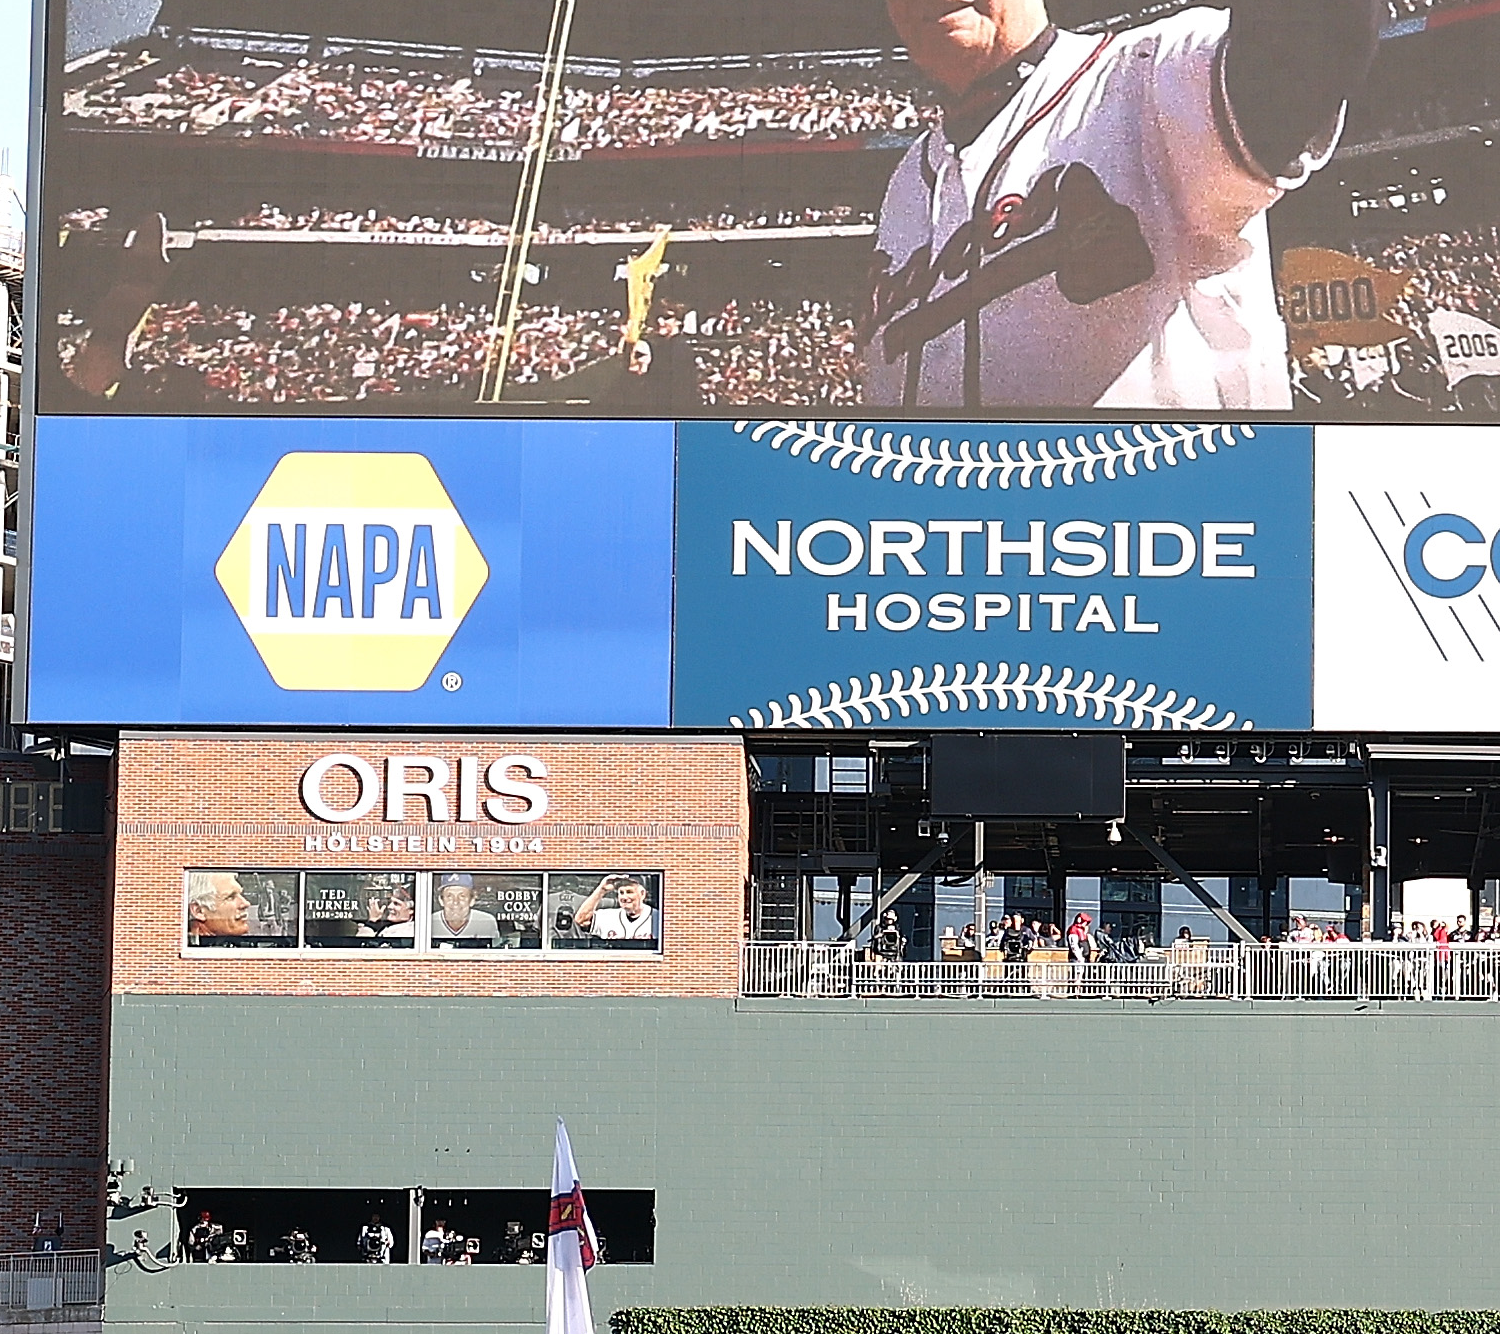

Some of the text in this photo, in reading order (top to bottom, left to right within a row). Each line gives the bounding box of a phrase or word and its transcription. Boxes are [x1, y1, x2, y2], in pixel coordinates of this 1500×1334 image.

[1444, 333, 1499, 358] 2006
[731, 518, 1256, 578] NORTHSIDE
[266, 523, 442, 619] NAPA
[826, 592, 1160, 634] HOSPITAL
[299, 753, 549, 825] ORIS
[305, 832, 544, 854] HÖLSTEIN 1904
[307, 900, 359, 910] TURNER
[320, 889, 347, 900] TED
[497, 890, 539, 901] BOBBY
[503, 902, 532, 912] COX
